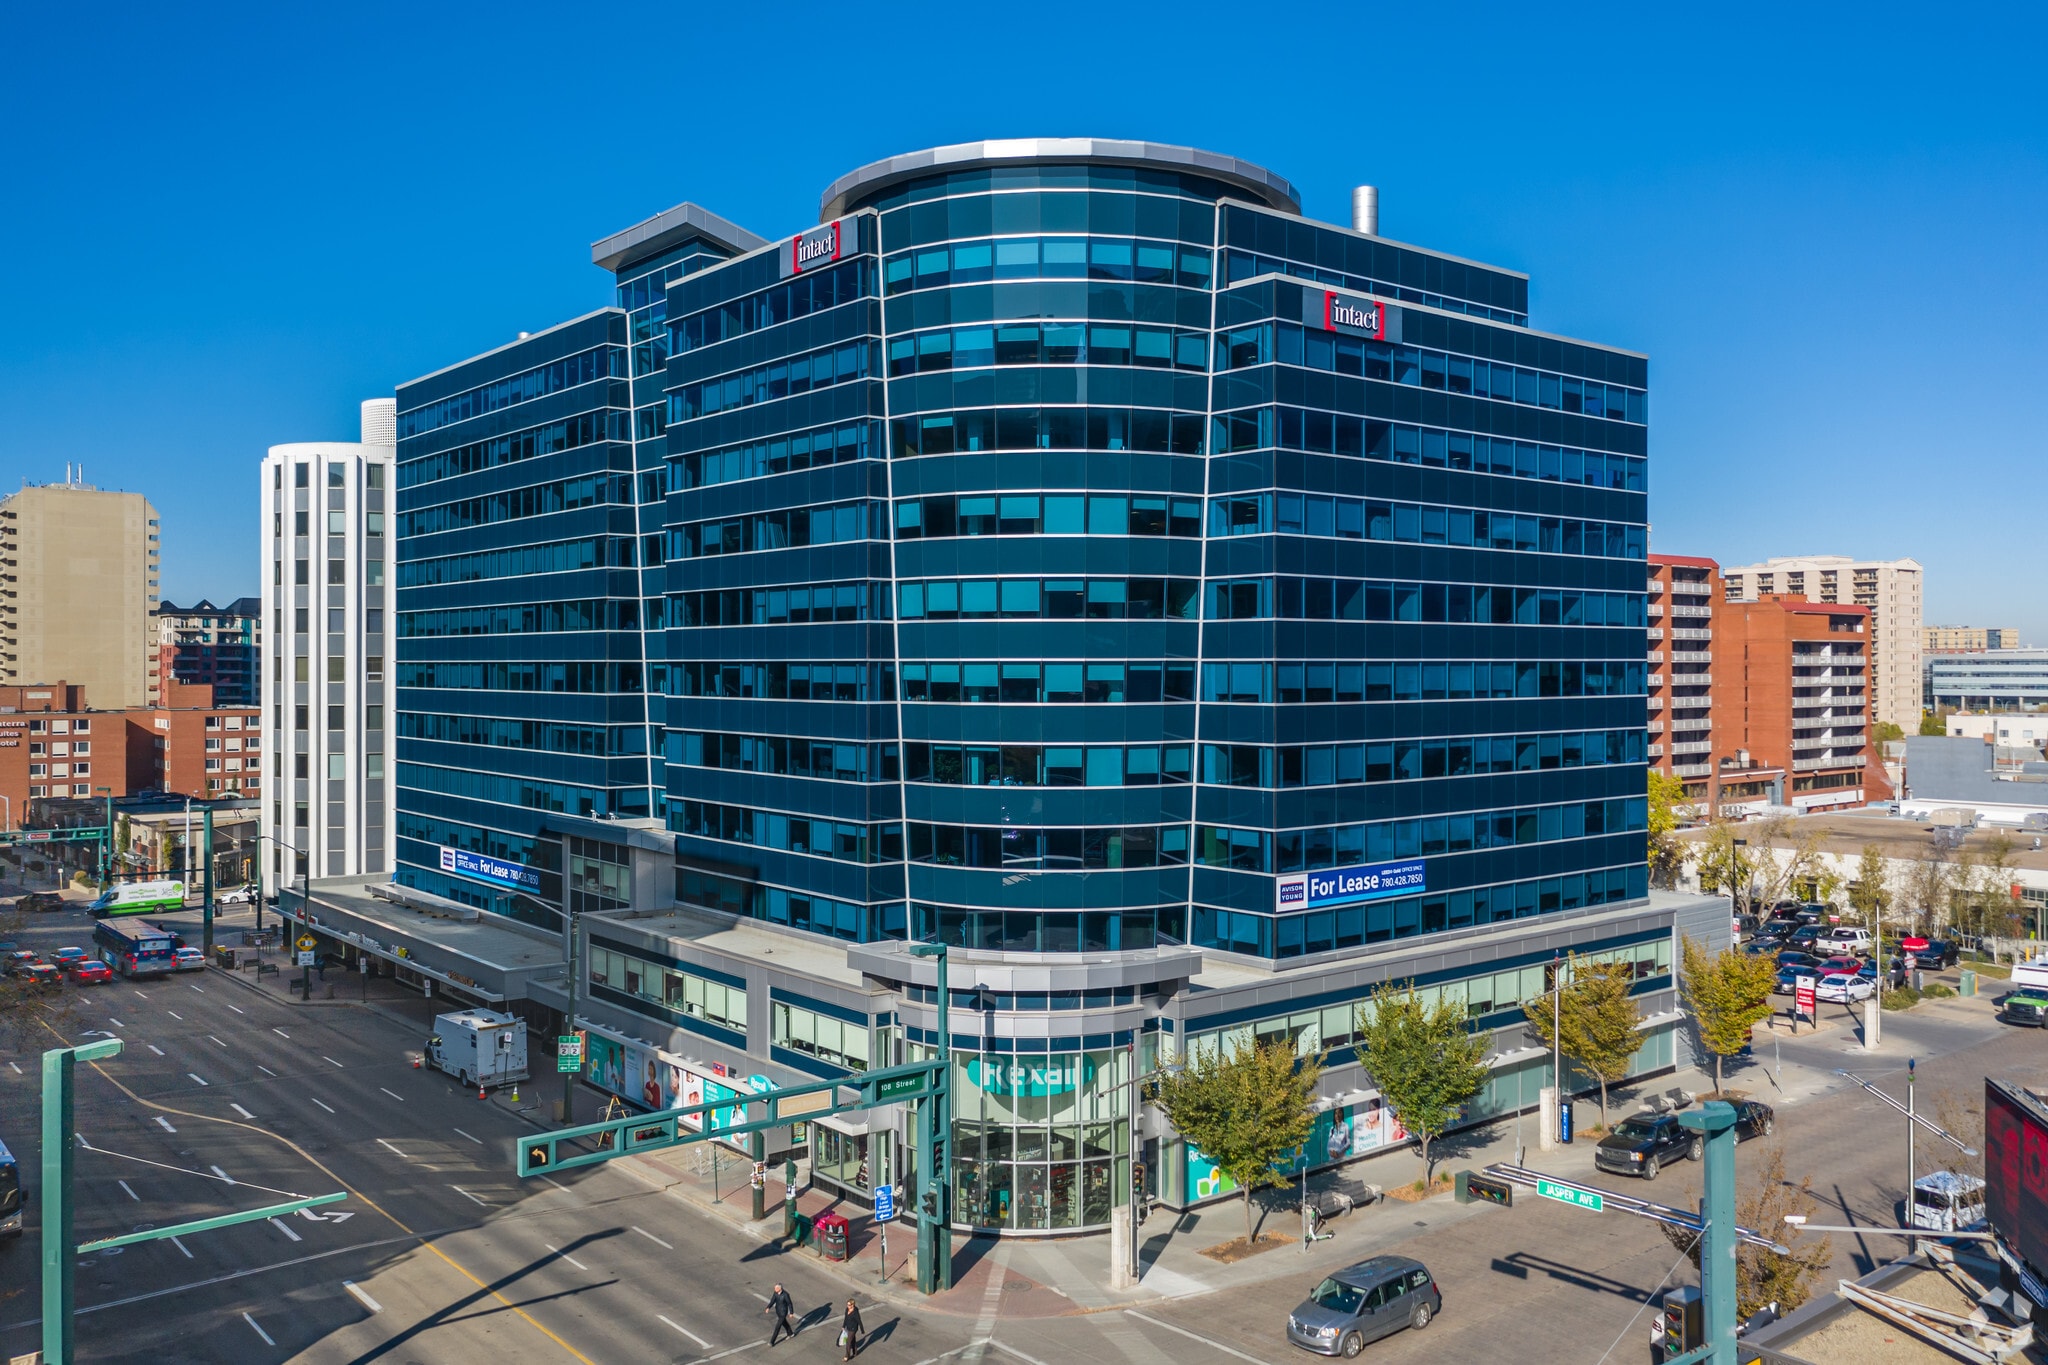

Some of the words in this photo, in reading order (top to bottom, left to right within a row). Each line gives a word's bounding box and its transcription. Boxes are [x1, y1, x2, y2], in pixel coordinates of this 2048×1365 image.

[480, 859, 490, 873] For
[490, 862, 509, 879] Lease
[1311, 878, 1335, 898] For
[1338, 874, 1380, 894] Lease
[1381, 873, 1423, 888] 780.428.7850
[1281, 893, 1303, 901] YOUNG
[983, 1054, 1080, 1090] Rexall
[881, 1083, 892, 1092] 108
[895, 1079, 916, 1089] Street
[1545, 1183, 1575, 1202] JASPER
[1578, 1192, 1594, 1207] AVE
